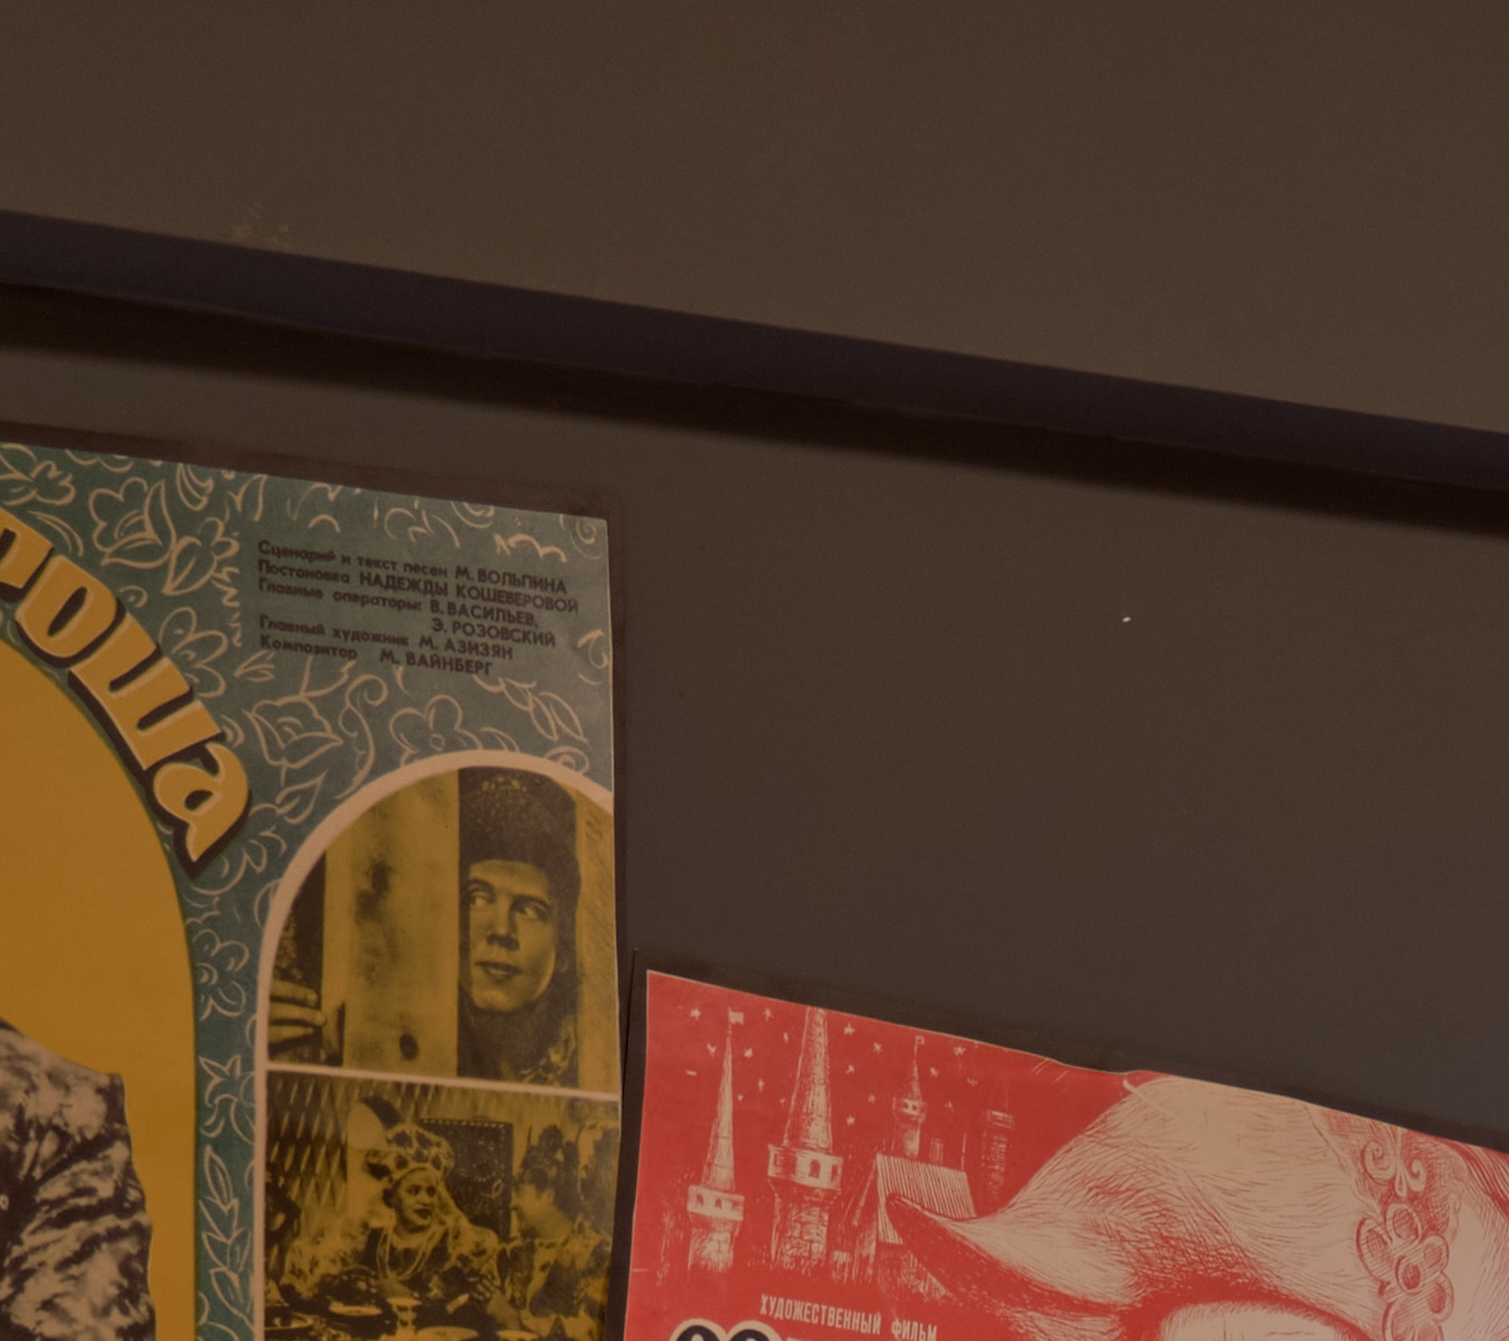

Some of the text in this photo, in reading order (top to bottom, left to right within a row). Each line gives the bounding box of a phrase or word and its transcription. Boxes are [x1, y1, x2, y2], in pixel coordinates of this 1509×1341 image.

[258, 540, 336, 562] Сценарий
[357, 555, 397, 573] текст
[403, 561, 447, 577] песен
[478, 568, 567, 594] ВОЛЬПИНА
[258, 561, 578, 614] Постановка НАДЕЖДЫ КОШЕВЕРОВОЙ
[258, 580, 324, 599] Главные
[332, 591, 422, 612] операторы:
[447, 602, 538, 628] ВАСИЛЬЕВ,
[260, 615, 326, 636] Главный
[332, 627, 409, 646] художник
[443, 638, 513, 660] АЗИЗЯН
[260, 635, 357, 661] Композитор
[405, 650, 493, 676] ВАЙНБЕРГ
[452, 620, 556, 647] РОЗОВСКИЙ
[759, 1294, 881, 1335] ХУДОЖЕСТВЕННЫЙ
